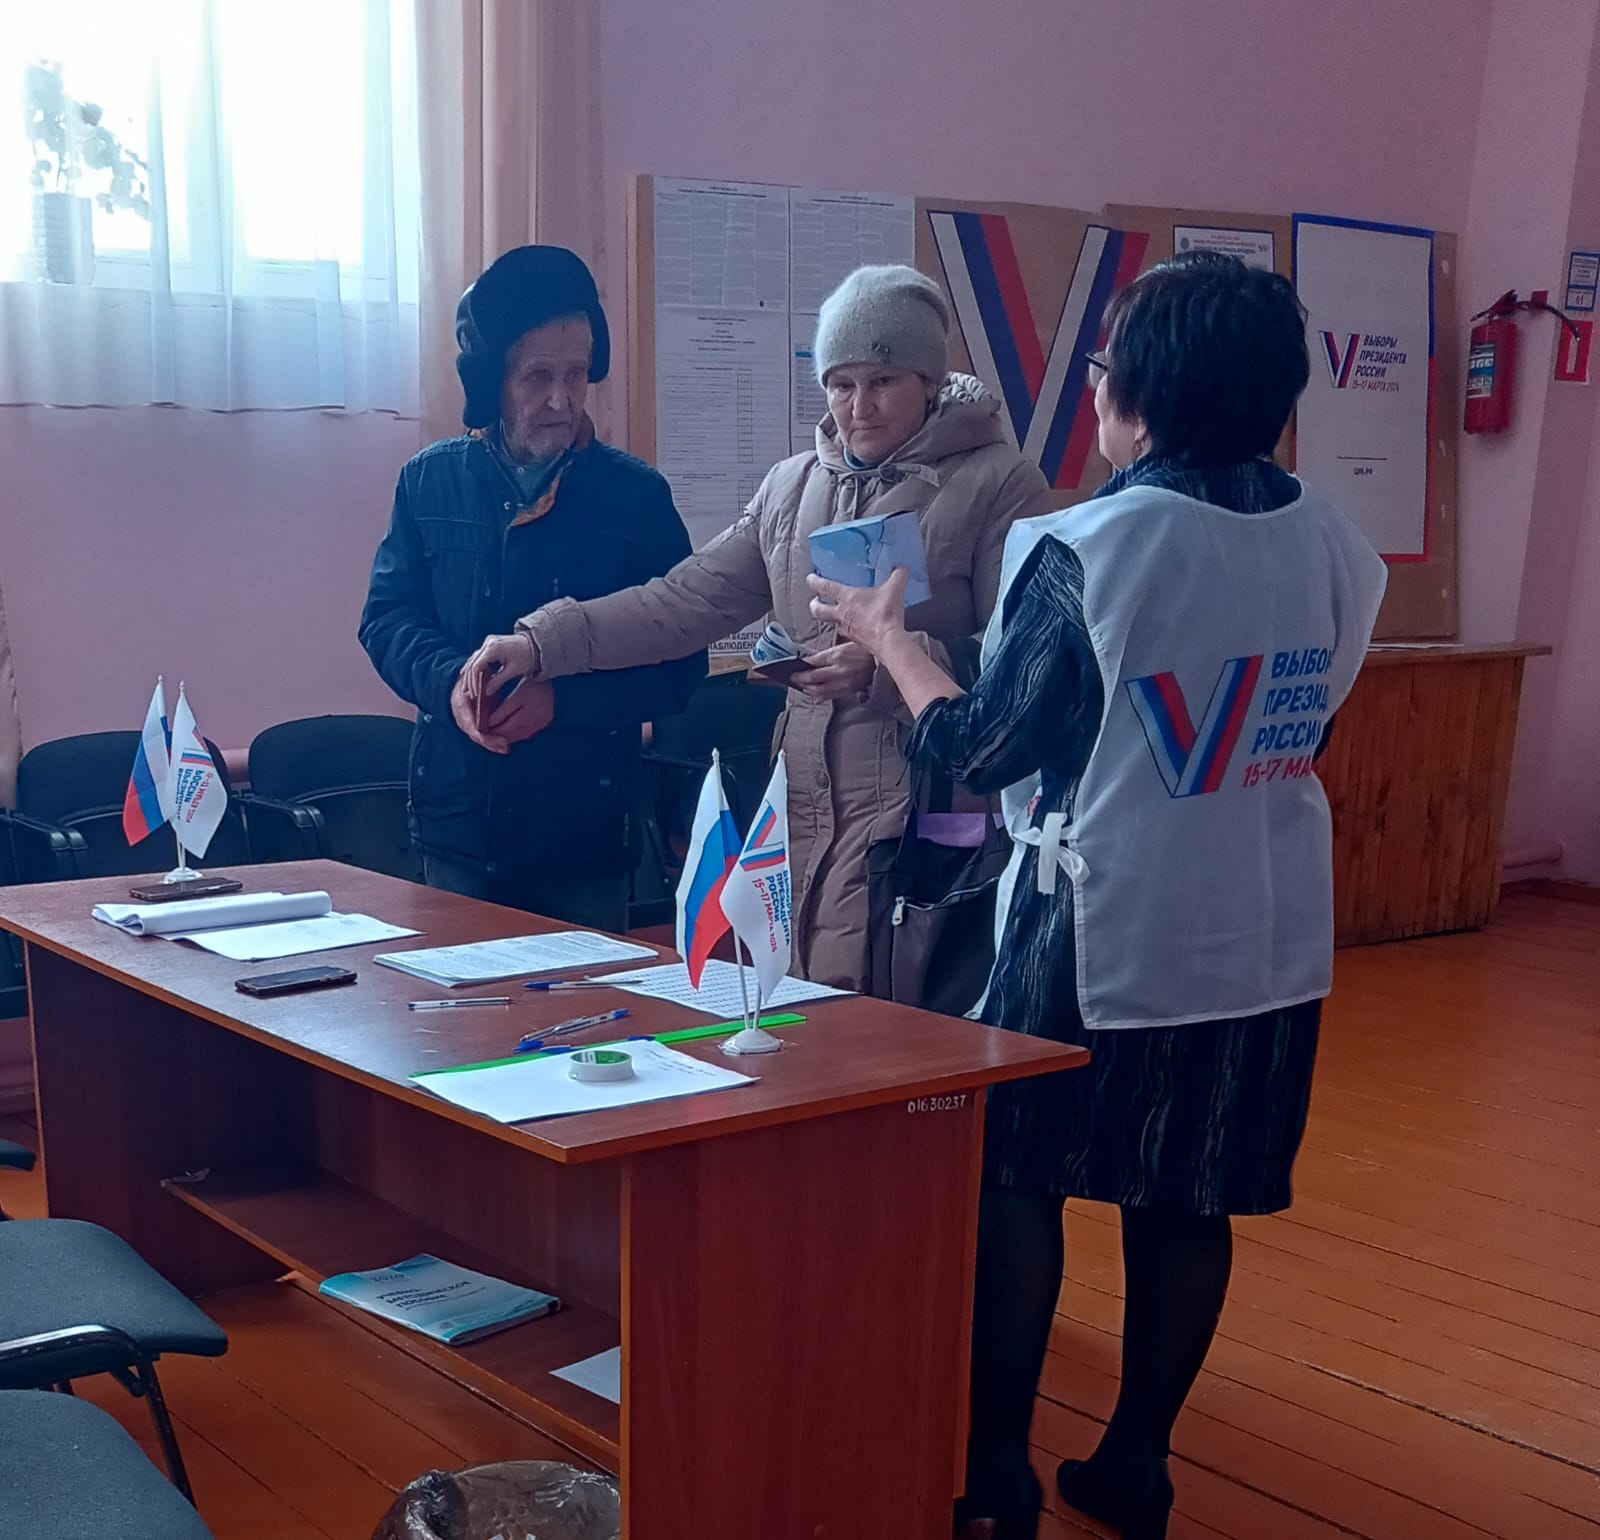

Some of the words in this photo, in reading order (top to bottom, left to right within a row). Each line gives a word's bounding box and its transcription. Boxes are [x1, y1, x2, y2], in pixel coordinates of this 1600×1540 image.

[1363, 334, 1398, 348] ВЫБОРЫ
[1359, 350, 1407, 365] ПРЕЗИДЕНТА
[1355, 365, 1387, 378] РОССИИ
[752, 878, 771, 901] 15-17
[765, 902, 775, 932] МАРТА
[765, 875, 780, 922] РОССИИ
[776, 873, 790, 946] ПРЕЗИДЕНТА
[907, 1095, 967, 1113] 01630237
